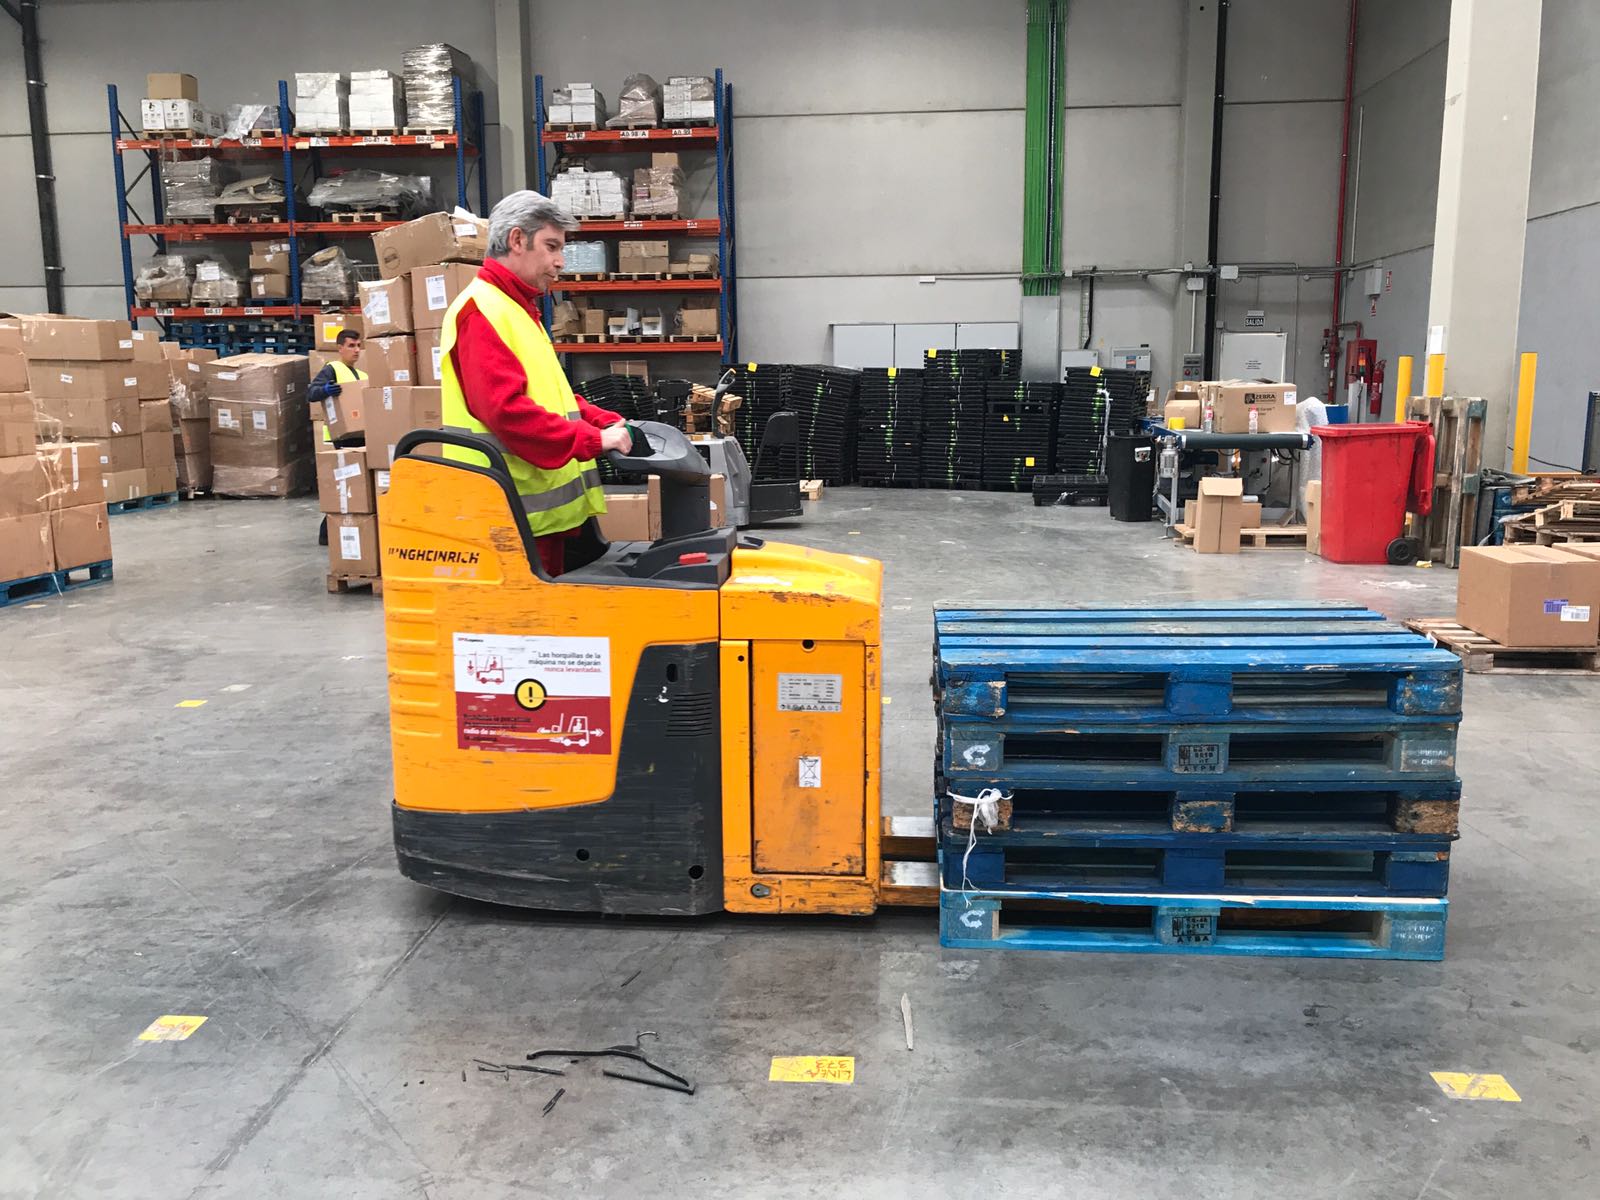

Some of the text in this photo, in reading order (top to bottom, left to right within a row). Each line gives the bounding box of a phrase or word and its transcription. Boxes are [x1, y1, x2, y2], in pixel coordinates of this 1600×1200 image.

[1246, 318, 1264, 326] SALIDA
[963, 744, 991, 766] C
[959, 909, 986, 929] C
